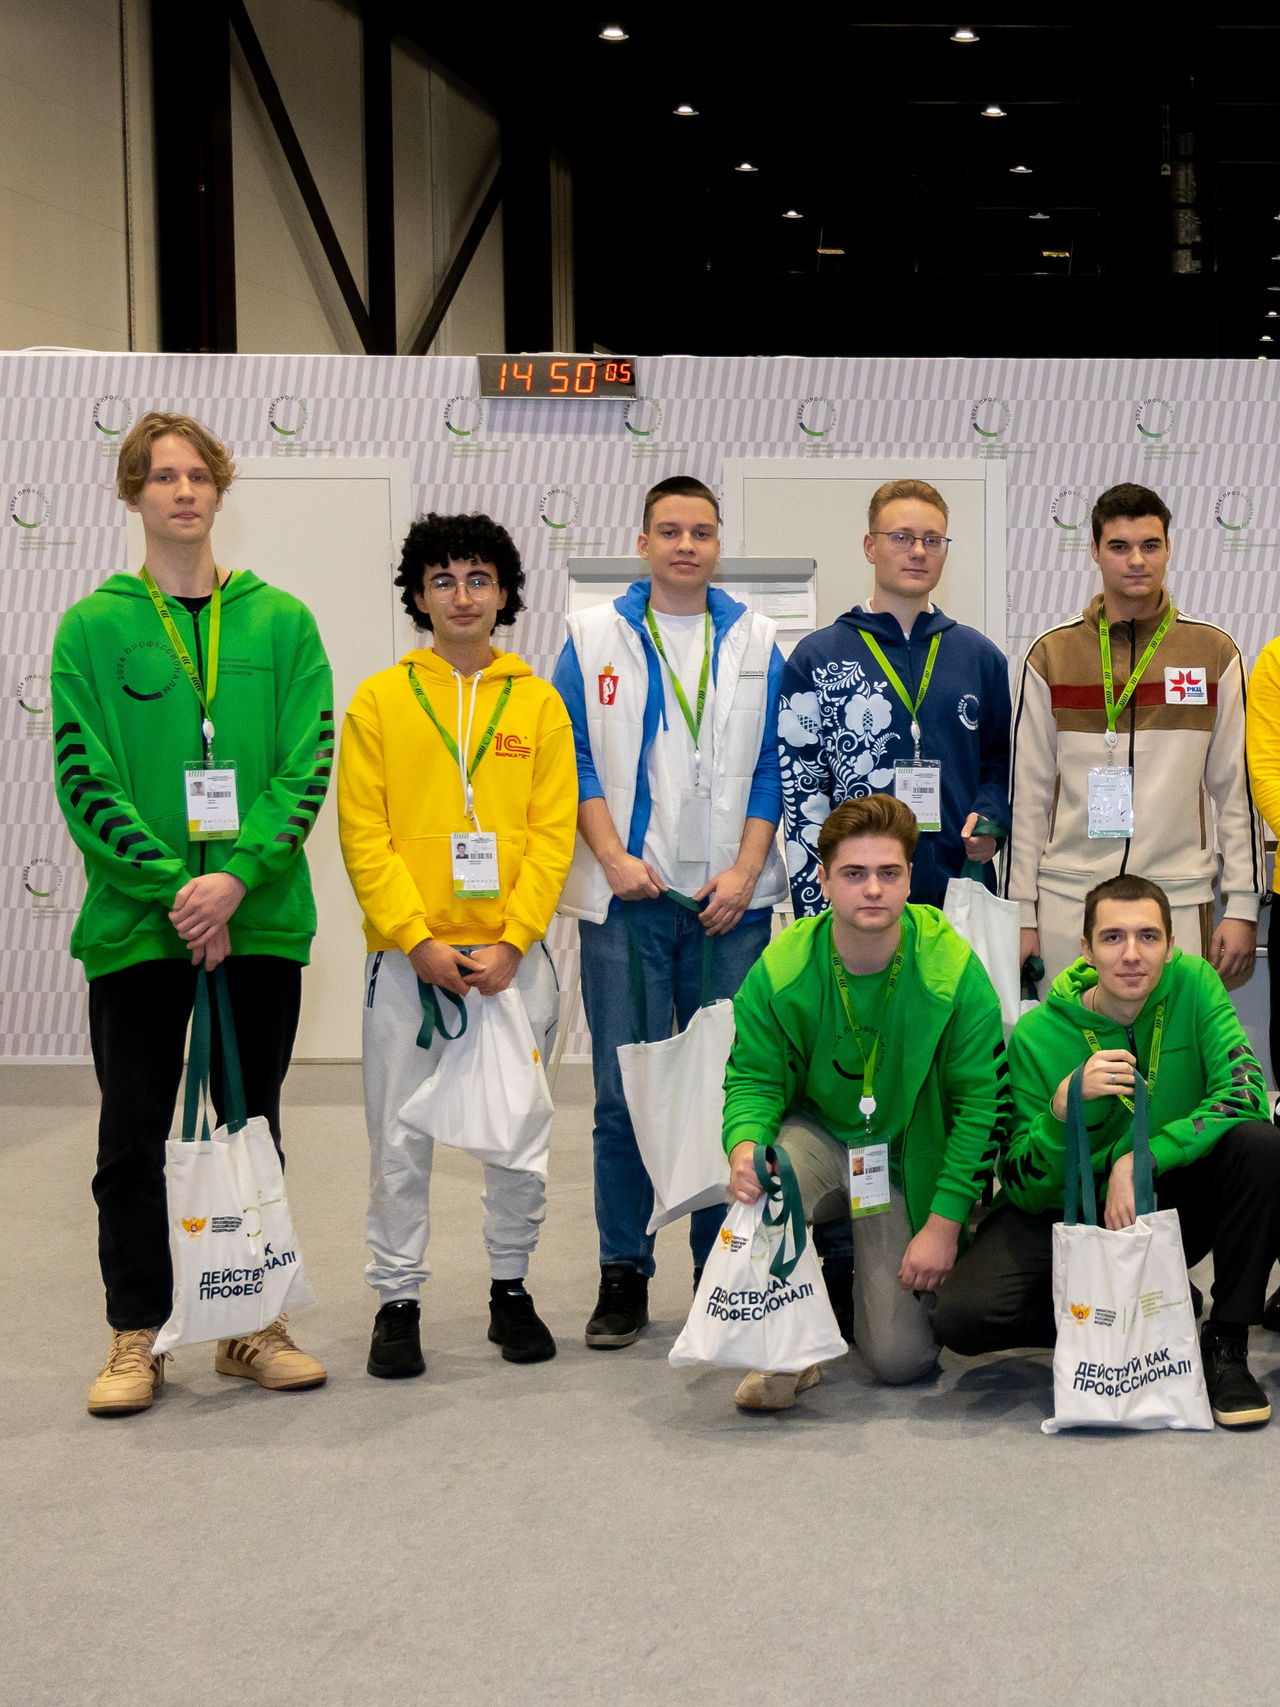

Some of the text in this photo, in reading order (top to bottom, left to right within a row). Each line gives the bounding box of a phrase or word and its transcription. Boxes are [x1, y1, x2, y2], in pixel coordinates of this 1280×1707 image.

[500, 361, 632, 394] 14 50 05
[117, 657, 126, 681] 2024
[200, 1268, 265, 1287] ДЕЙСТВУ
[709, 1286, 768, 1306] ДЕЙСТВУ
[1144, 1347, 1171, 1367] КАК
[1073, 1360, 1192, 1397] ПРОФЕССИОНАЛ!
